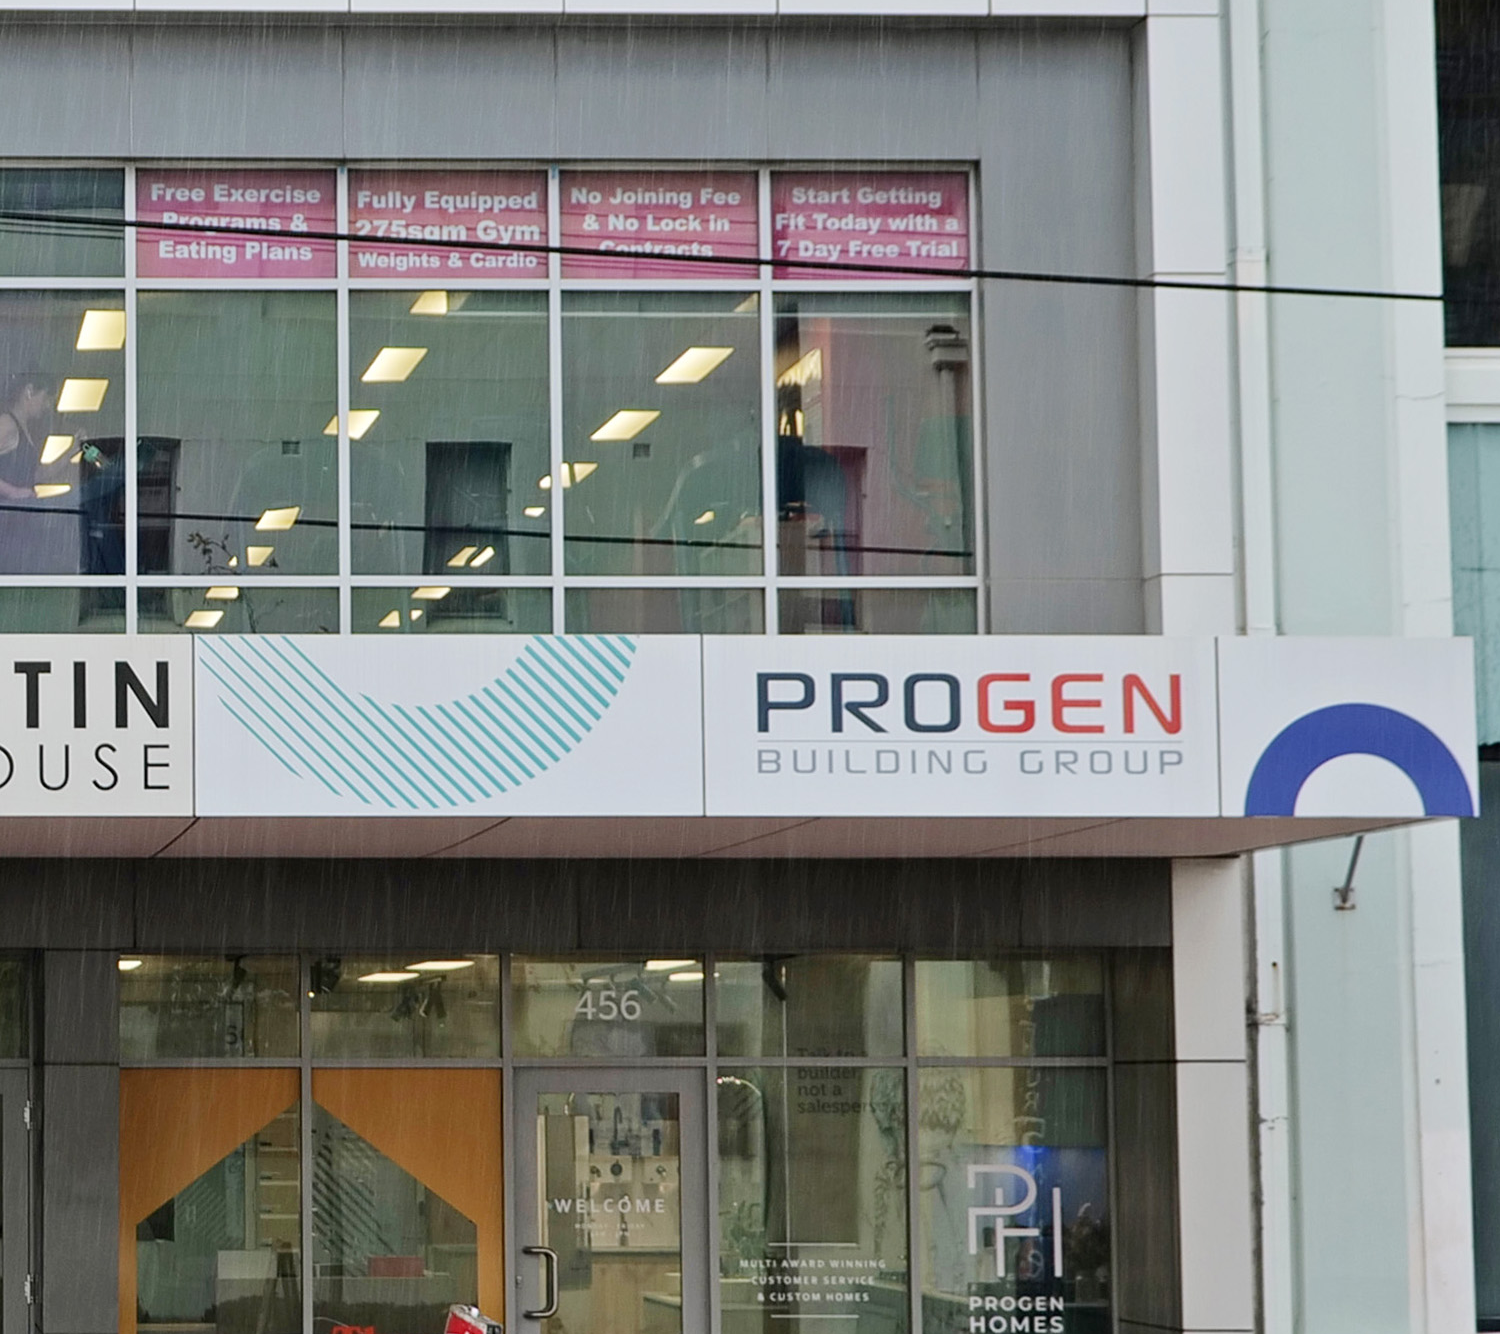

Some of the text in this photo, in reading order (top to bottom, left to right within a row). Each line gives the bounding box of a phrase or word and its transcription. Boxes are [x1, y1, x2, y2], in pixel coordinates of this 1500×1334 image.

[151, 183, 321, 204] Free Exercise
[357, 190, 538, 214] Fully Equipped
[571, 187, 741, 209] No Joining Fee
[791, 186, 942, 209] Start Getting
[162, 212, 308, 235] Programs &
[476, 219, 541, 245] Gym
[582, 213, 731, 231] & No Lock in
[775, 213, 959, 234] Fit Today with a
[158, 240, 313, 264] Eating Plans
[777, 240, 958, 261] 7 Day Free Trial
[358, 251, 538, 272] Weights & Cardio
[757, 672, 1182, 735] PROGEN
[757, 749, 1183, 775] BUILDING GROUP
[575, 989, 641, 1020] 456
[798, 1083, 827, 1096] not
[554, 1198, 665, 1213] WELCOME
[739, 1259, 886, 1268] MULTI AWARD WINNING
[751, 1276, 875, 1285] CUSTOMER SERVICE
[769, 1292, 821, 1302] CUSTOM
[826, 1292, 870, 1302] HOMES
[969, 1296, 1064, 1311] PROGEN
[969, 1316, 1064, 1334] HOMES
